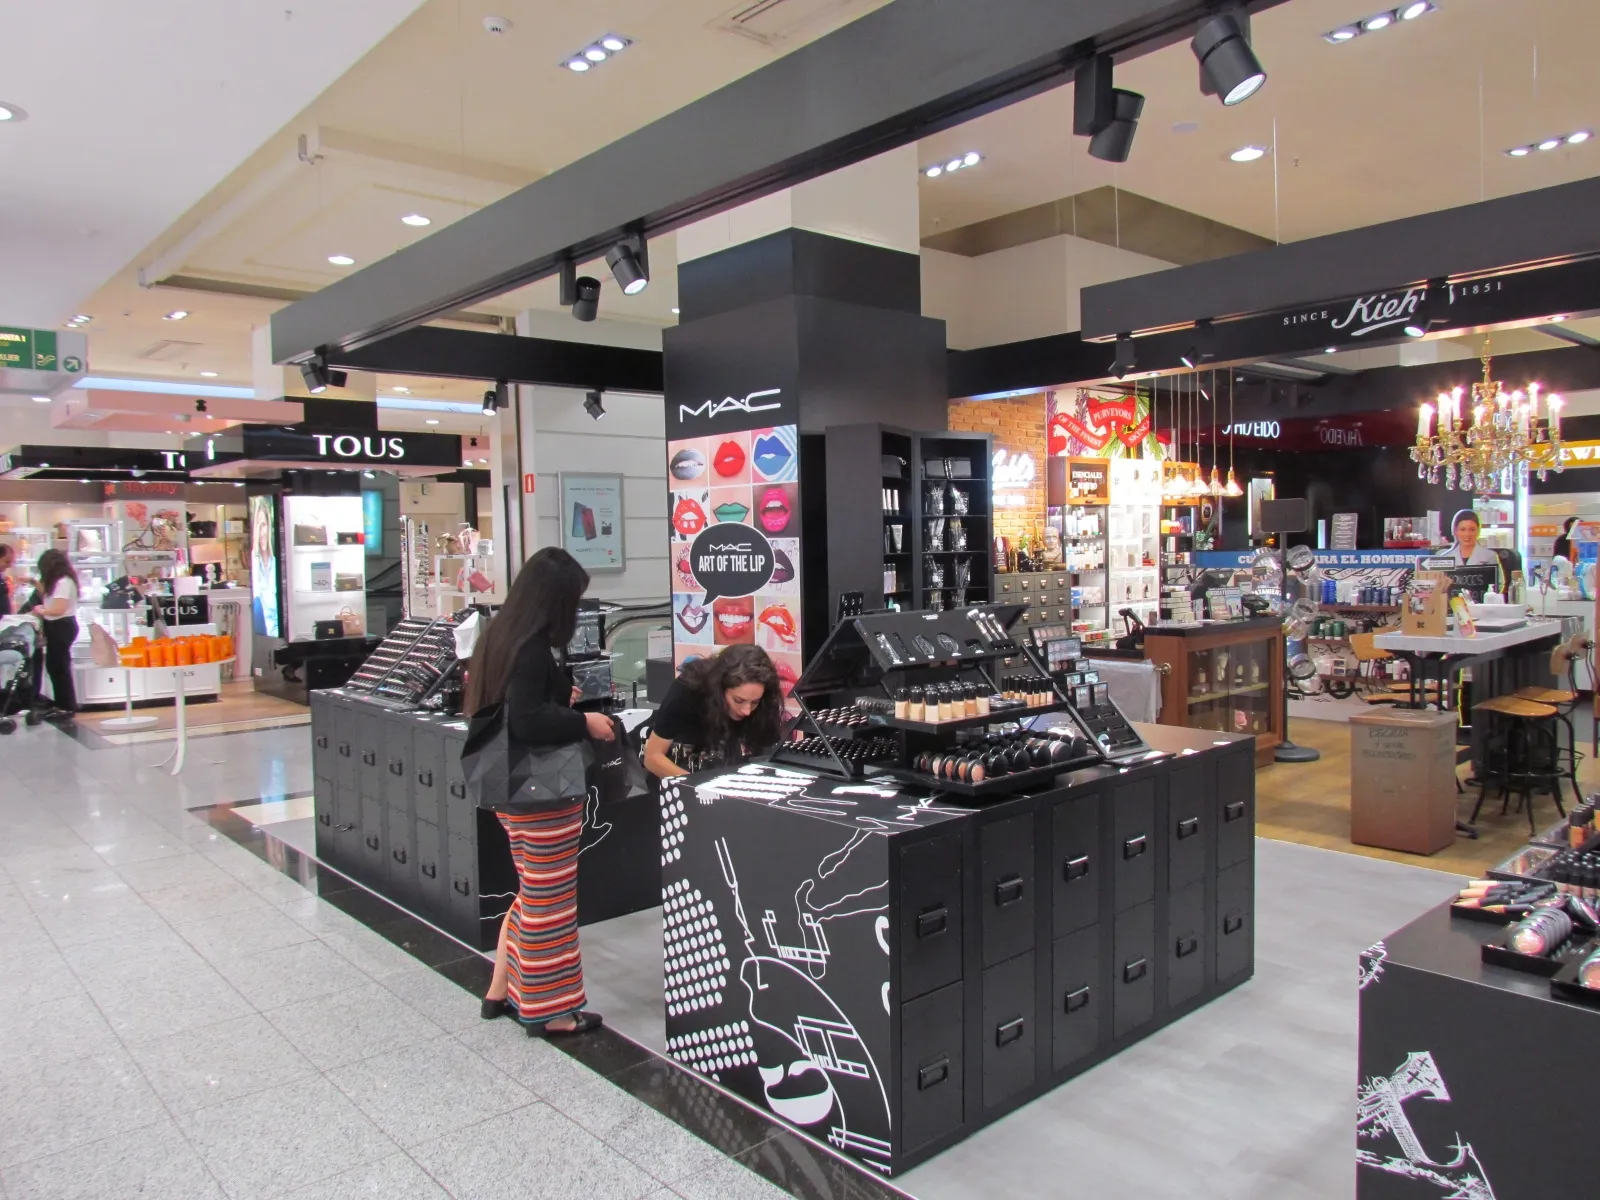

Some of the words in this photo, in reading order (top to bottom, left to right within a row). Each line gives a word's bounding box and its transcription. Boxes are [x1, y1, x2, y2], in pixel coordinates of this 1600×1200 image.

[1283, 310, 1329, 326] SINCE
[1462, 281, 1503, 296] 1851
[1093, 407, 1132, 422] PURVEYORS
[312, 434, 405, 458] TOUS
[699, 555, 716, 572] ART
[716, 554, 729, 572] OF
[729, 554, 748, 572] THE
[749, 554, 766, 572] LIP
[1340, 555, 1358, 564] EL
[1360, 555, 1417, 564] HOMBR
[160, 606, 198, 616] TOUS
